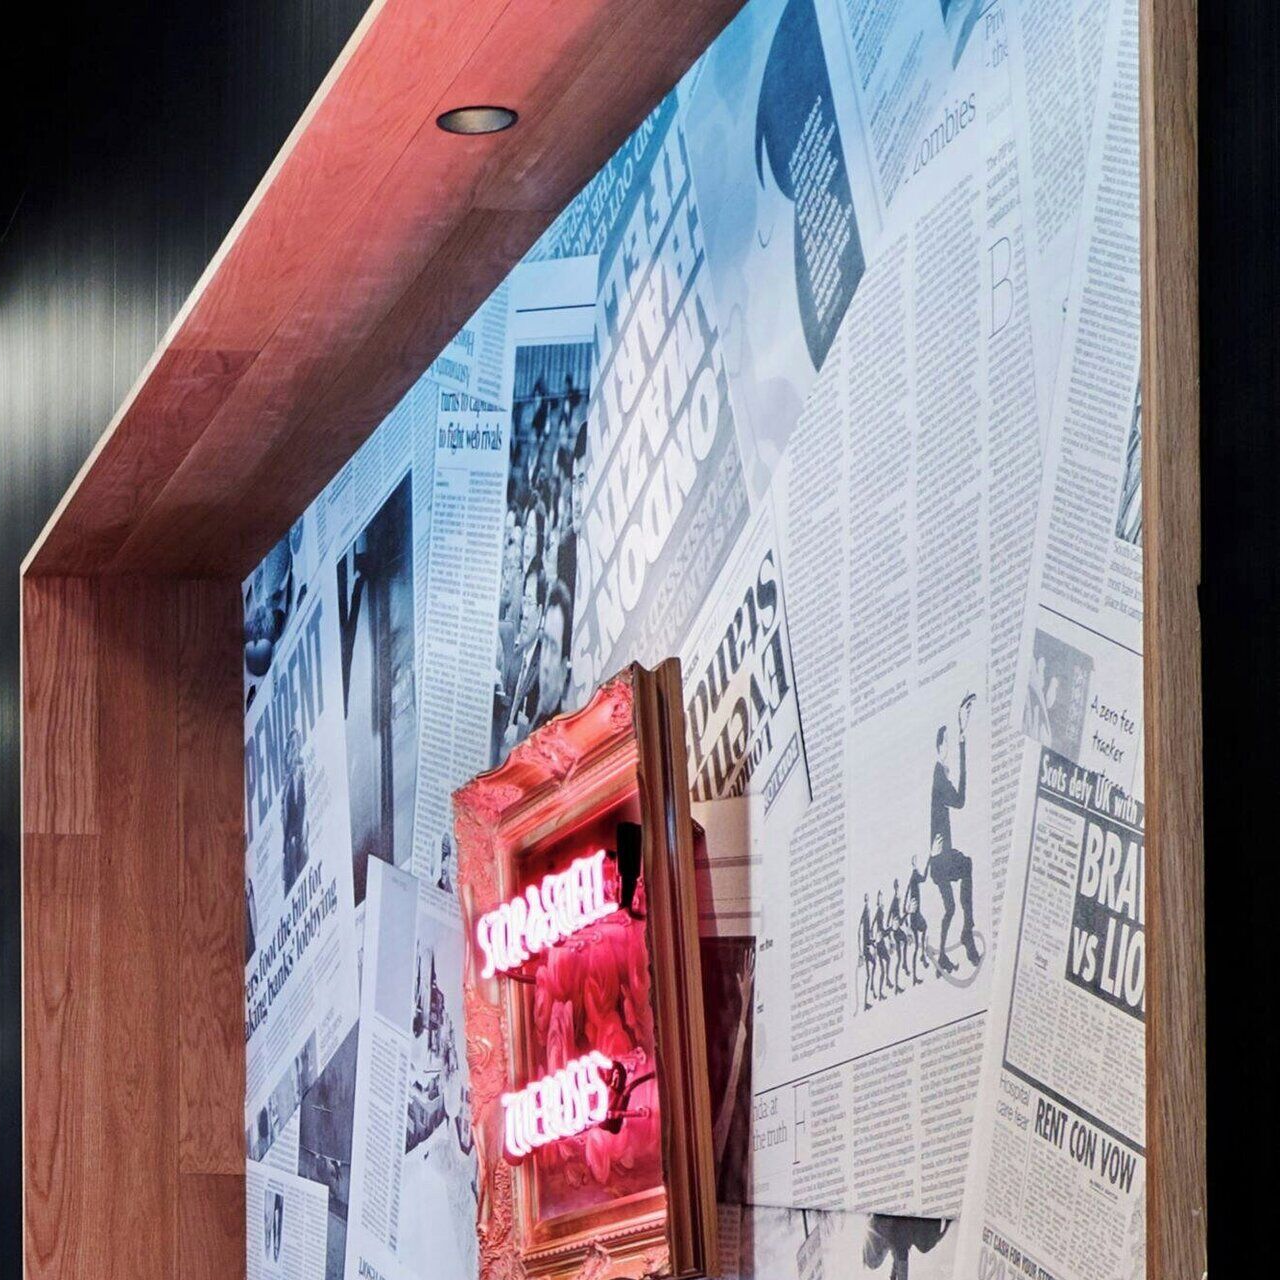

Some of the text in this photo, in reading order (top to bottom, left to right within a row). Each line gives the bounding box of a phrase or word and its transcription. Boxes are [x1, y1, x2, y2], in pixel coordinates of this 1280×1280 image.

[913, 92, 976, 176] zombies
[447, 422, 464, 456] fight
[466, 423, 480, 449] web
[481, 422, 502, 451] rivals
[1041, 754, 1068, 793] Scots
[1070, 766, 1094, 810] defy
[1094, 775, 1114, 814] UK
[1114, 795, 1139, 825] with
[258, 859, 323, 982] foot the bill for
[295, 877, 338, 961] lobbying
[1072, 925, 1099, 984] vs
[1034, 1097, 1137, 1195] RENT CON VOW
[982, 1226, 993, 1245] GET
[994, 1234, 1010, 1258] CASH
[1010, 1243, 1021, 1265] FOR
[1022, 1250, 1037, 1278] YOUR
